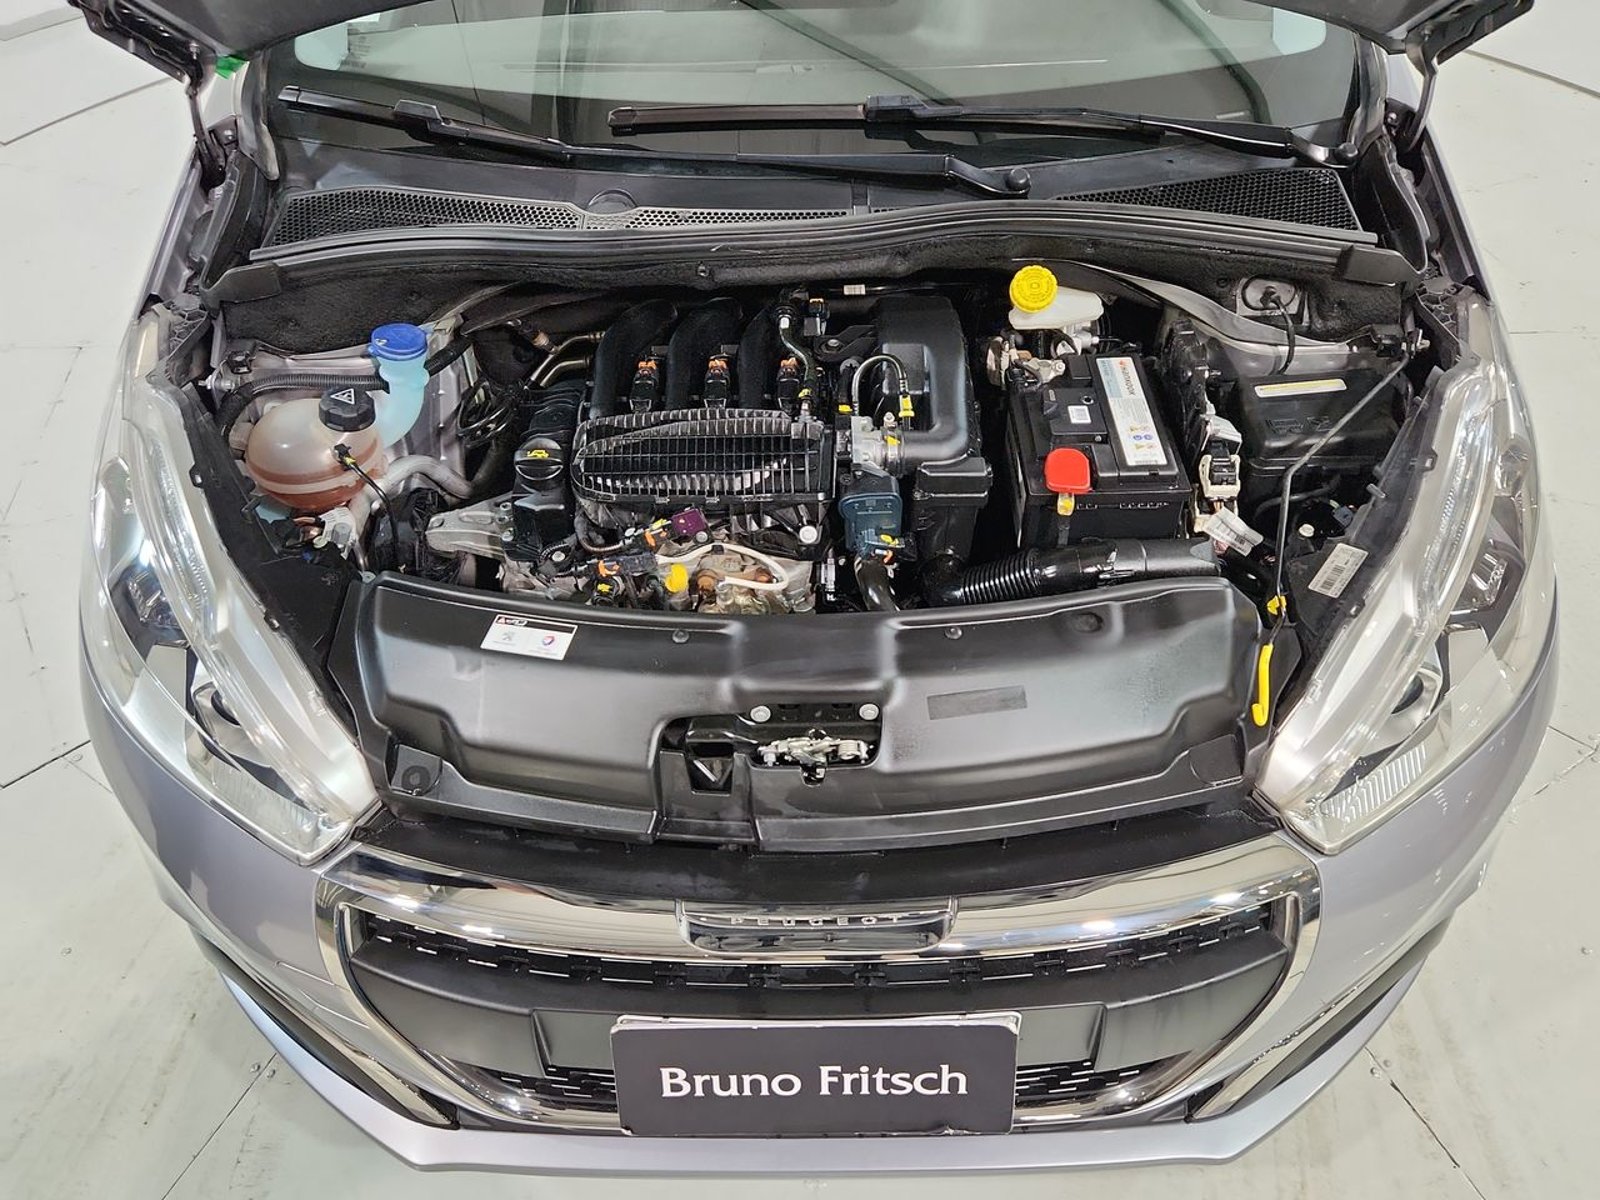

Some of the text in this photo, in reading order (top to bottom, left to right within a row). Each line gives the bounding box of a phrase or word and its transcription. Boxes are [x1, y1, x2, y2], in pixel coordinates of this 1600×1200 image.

[730, 914, 902, 927] PEUGEOT
[660, 1064, 968, 1098] Bruno Fritsch
